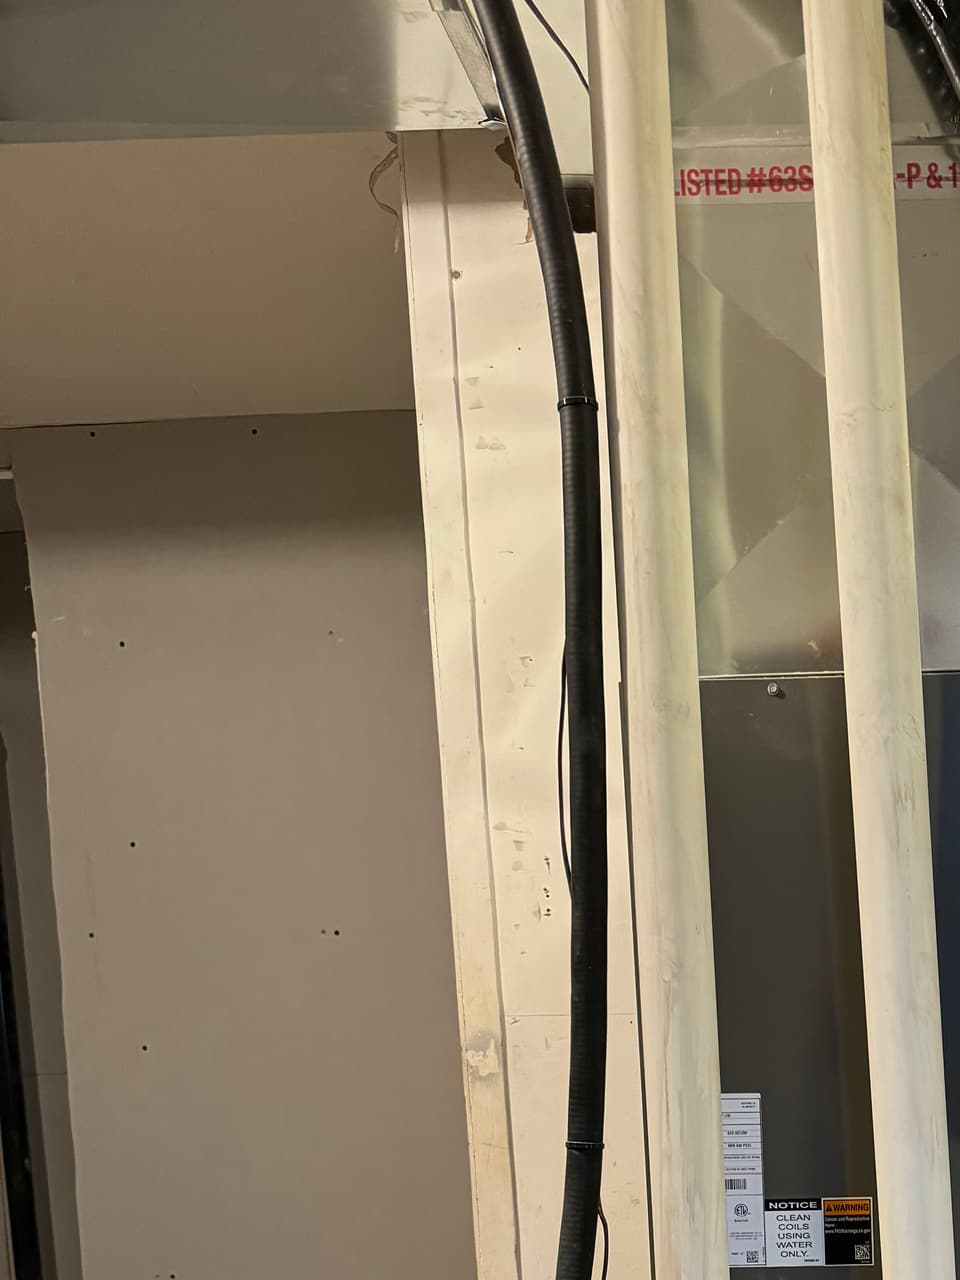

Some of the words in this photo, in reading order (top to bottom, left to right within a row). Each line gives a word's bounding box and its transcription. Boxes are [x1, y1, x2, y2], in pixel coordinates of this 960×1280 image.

[926, 162, 943, 189] &
[768, 1201, 818, 1210] NOTICE
[833, 1203, 869, 1212] WARNING
[778, 1223, 809, 1231] COILS
[776, 1241, 813, 1249] WATER
[780, 1250, 808, 1258] ONLY.
